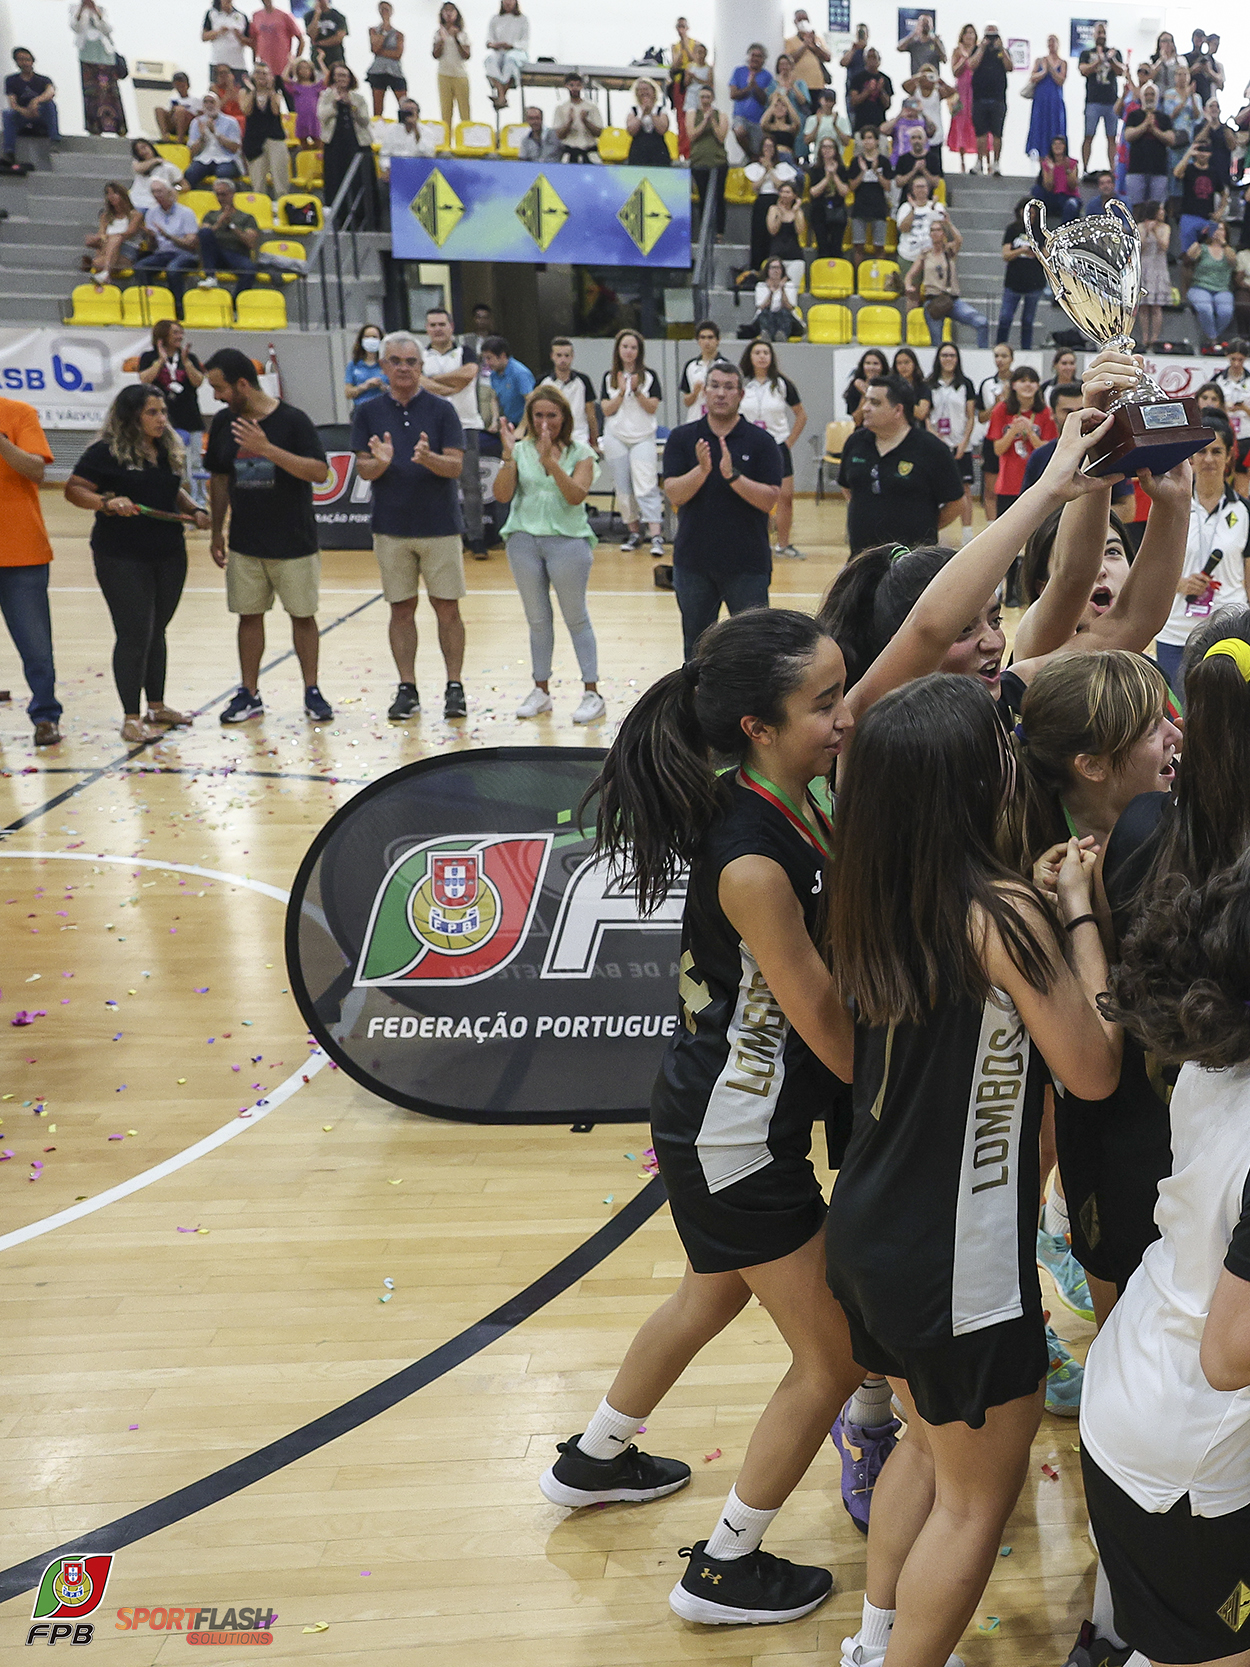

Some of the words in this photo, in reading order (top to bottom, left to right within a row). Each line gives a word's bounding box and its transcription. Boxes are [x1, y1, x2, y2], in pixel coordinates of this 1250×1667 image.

[0, 367, 46, 391] SB
[367, 1011, 528, 1043] FEDERAÇÃO
[534, 1014, 680, 1039] PORTUGUE
[971, 1024, 1026, 1195] LOMBOS
